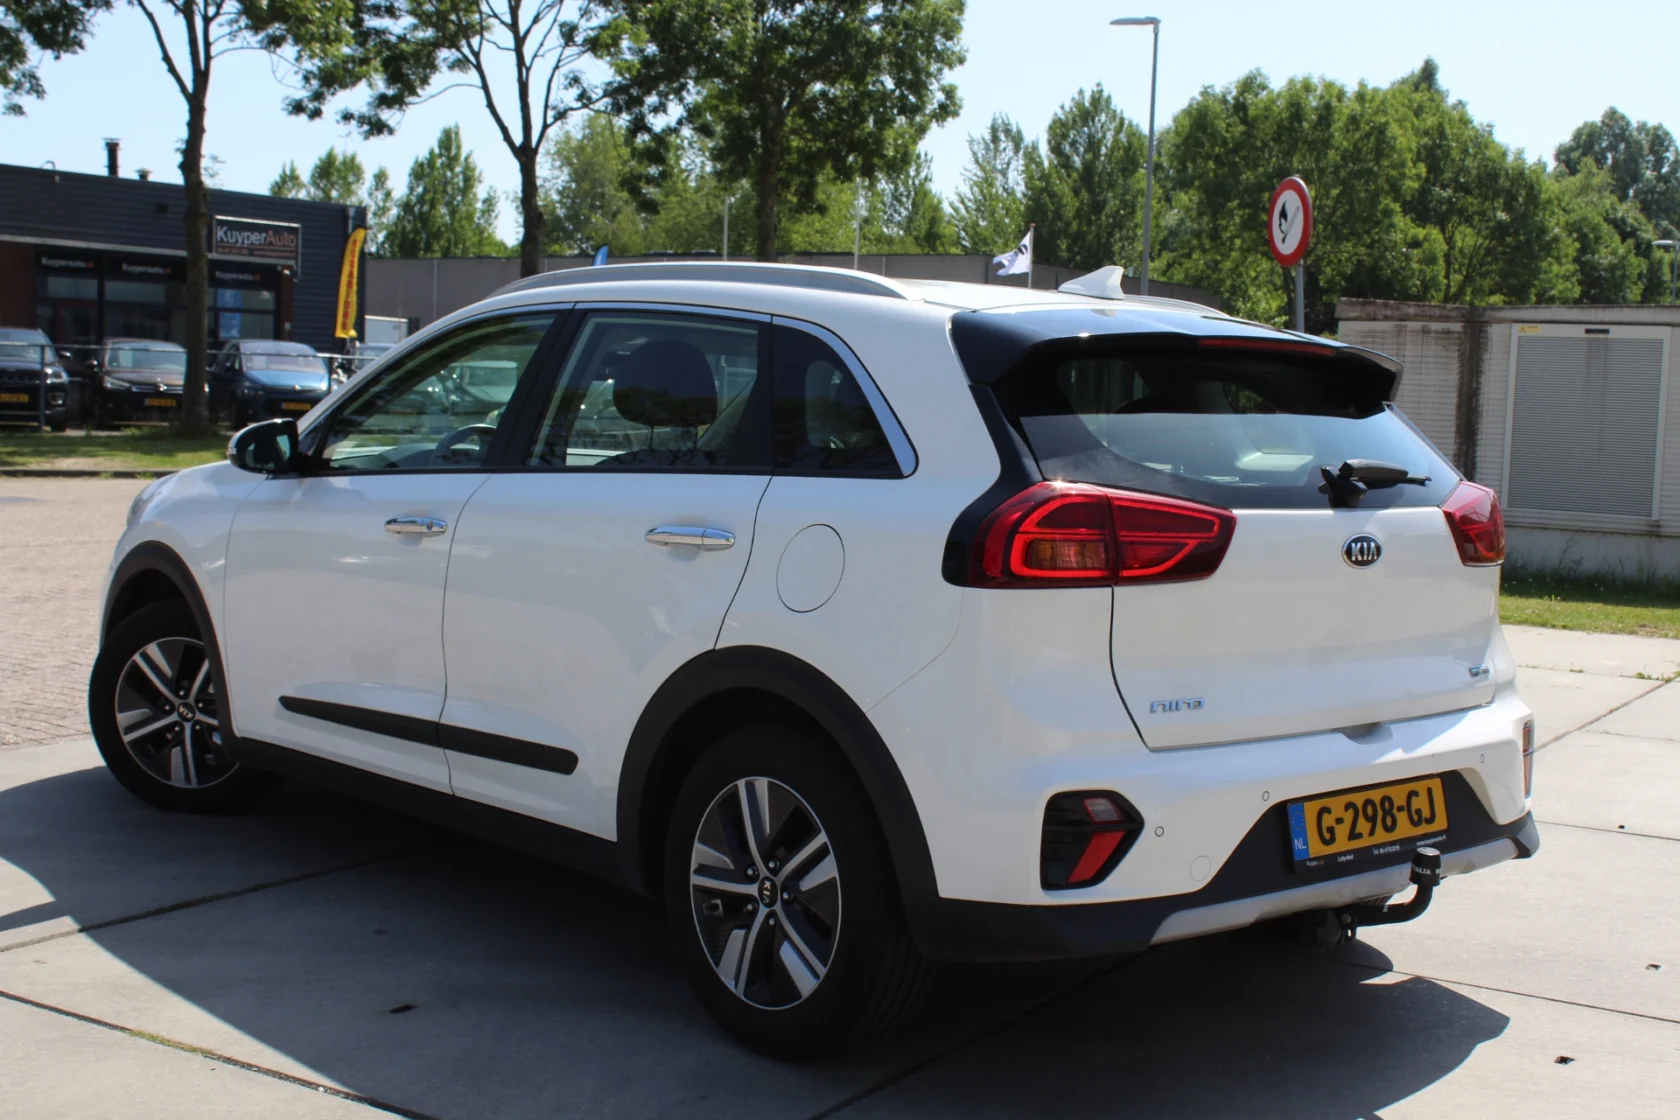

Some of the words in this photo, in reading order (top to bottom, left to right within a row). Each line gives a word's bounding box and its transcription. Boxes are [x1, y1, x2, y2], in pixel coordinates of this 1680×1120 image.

[216, 225, 297, 247] KuyperAuto
[1350, 541, 1378, 561] KIA
[1316, 786, 1437, 847] G-298-GJ
[1294, 837, 1307, 850] NL
